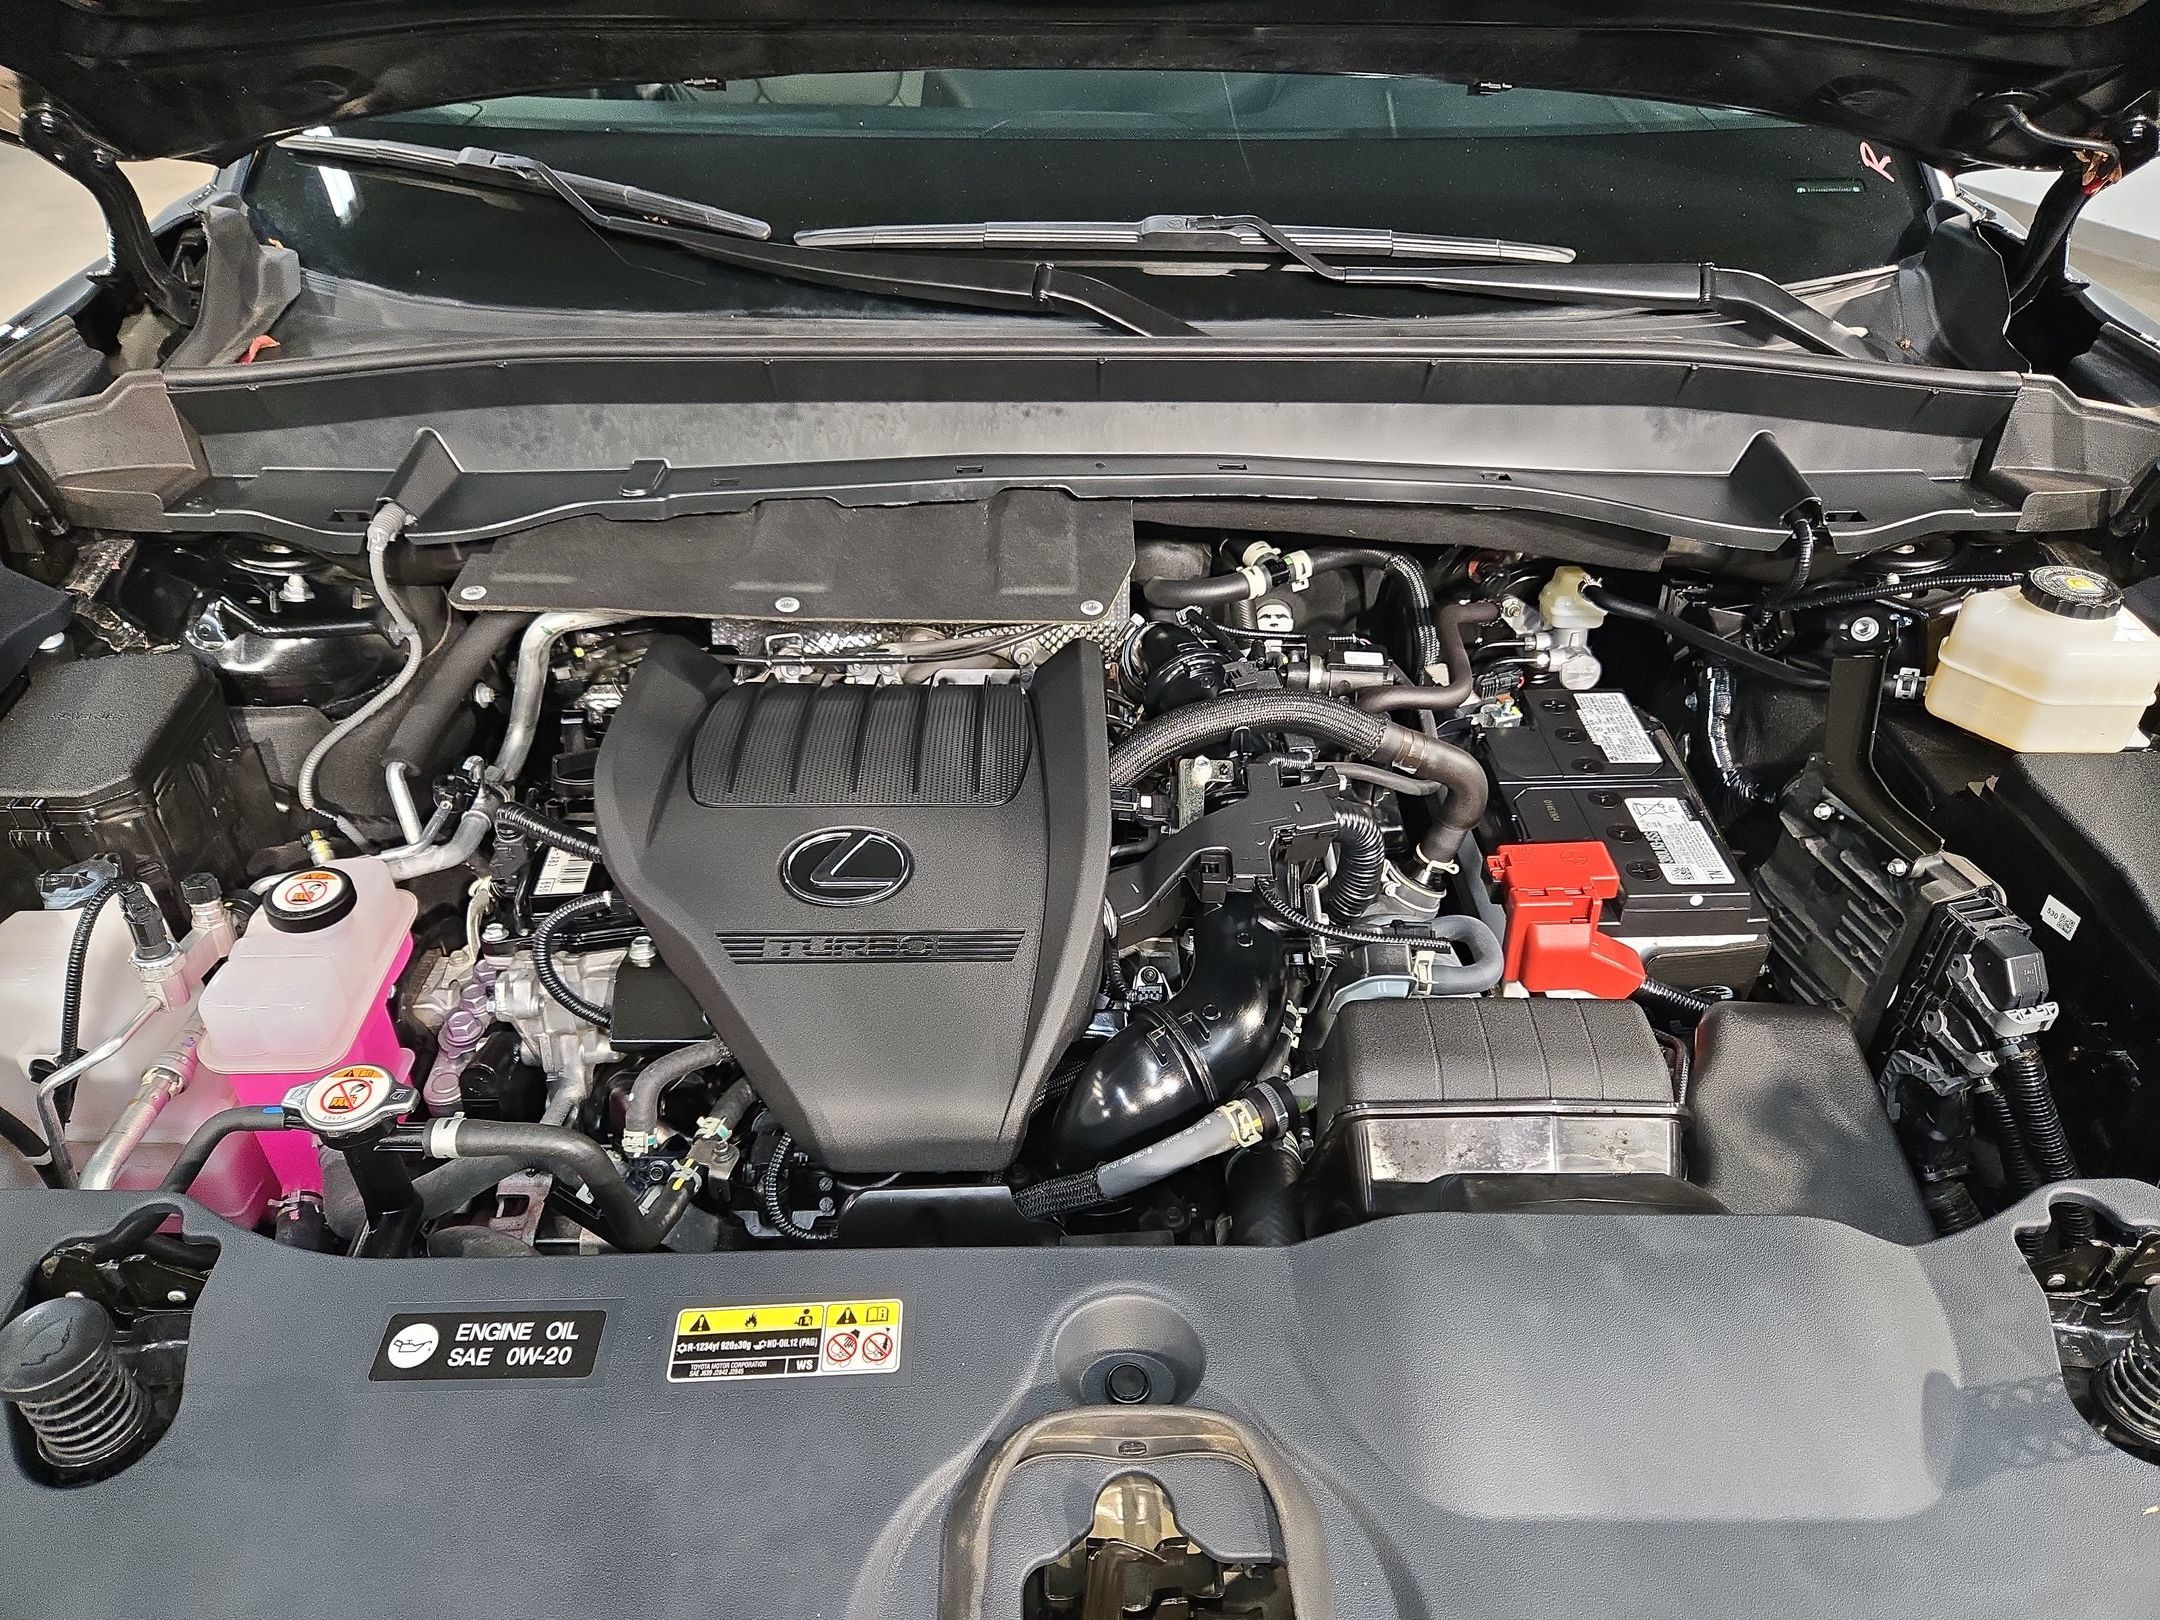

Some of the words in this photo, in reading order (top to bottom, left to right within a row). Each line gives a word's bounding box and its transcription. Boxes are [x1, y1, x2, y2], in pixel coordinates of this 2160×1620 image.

[2046, 907, 2059, 920] 530
[766, 935, 937, 957] TURBO
[455, 1322, 536, 1342] ENGINE
[545, 1321, 580, 1341] OIL
[687, 1341, 720, 1353] R-1234yf
[799, 1337, 818, 1348] (PAG)
[447, 1347, 494, 1367] SAE
[506, 1346, 573, 1366] 0W-20
[690, 1363, 711, 1371] TOYOTA
[711, 1362, 731, 1370] MOTOR
[730, 1360, 768, 1369] CORPORATION
[796, 1359, 814, 1371] WS
